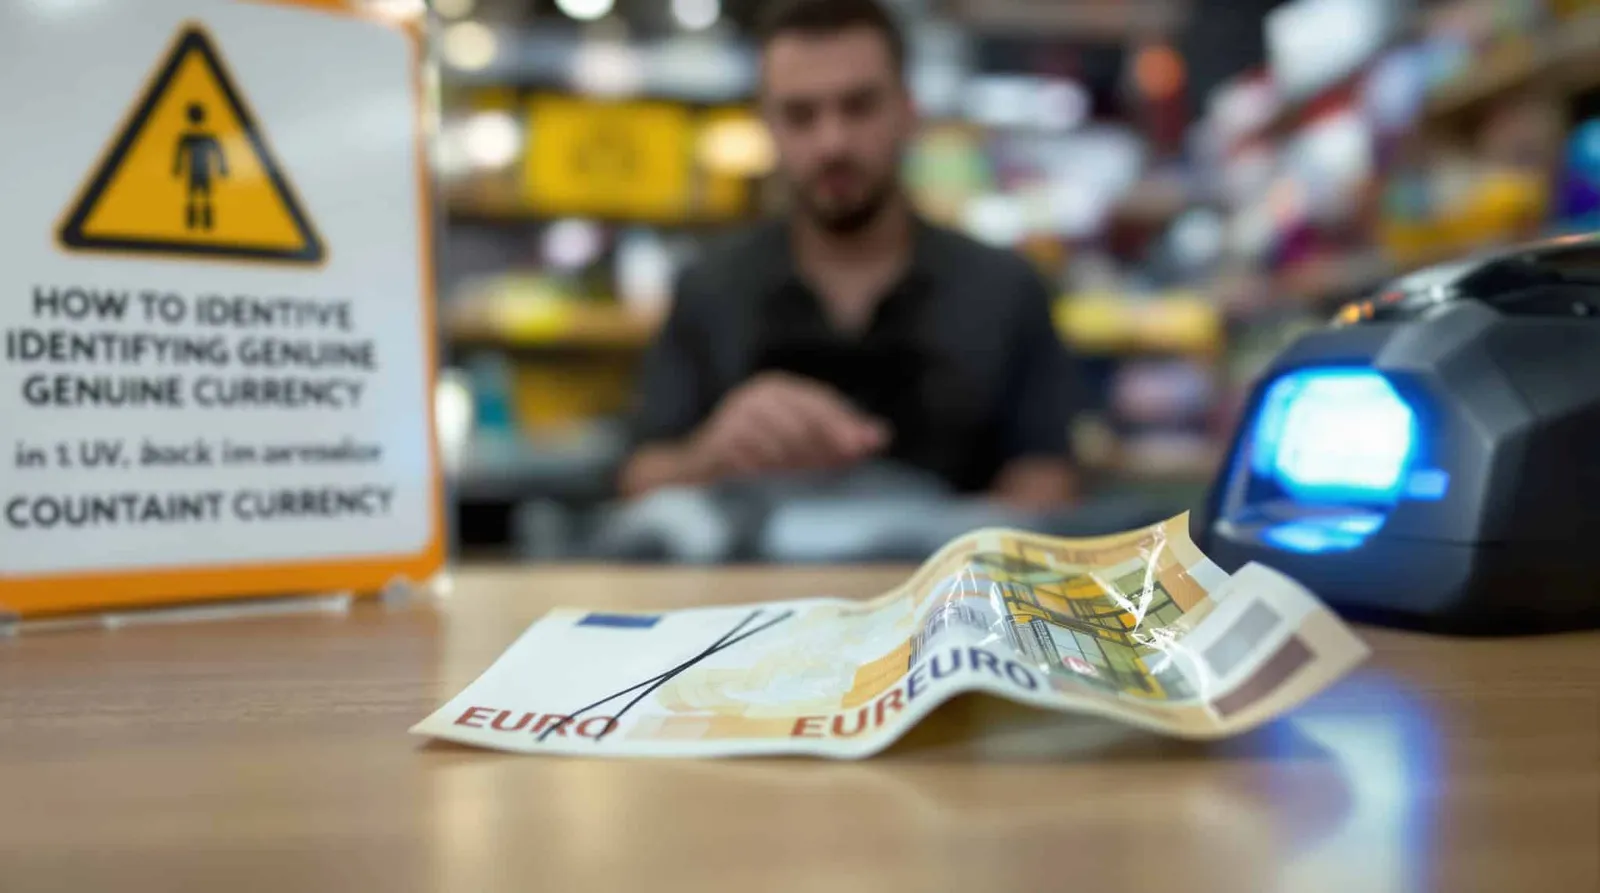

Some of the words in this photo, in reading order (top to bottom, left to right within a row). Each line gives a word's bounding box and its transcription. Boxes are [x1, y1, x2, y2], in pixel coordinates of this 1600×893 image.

[33, 285, 129, 320] HOW
[138, 289, 187, 325] TO
[6, 328, 228, 366] IDENTIFYING
[236, 337, 377, 373] GENUINE
[22, 374, 183, 407] GENUINE
[192, 376, 363, 408] CURRENCY
[6, 490, 223, 528] COUNTAINT
[233, 484, 394, 520] CURRENCY
[453, 705, 620, 738] EURO
